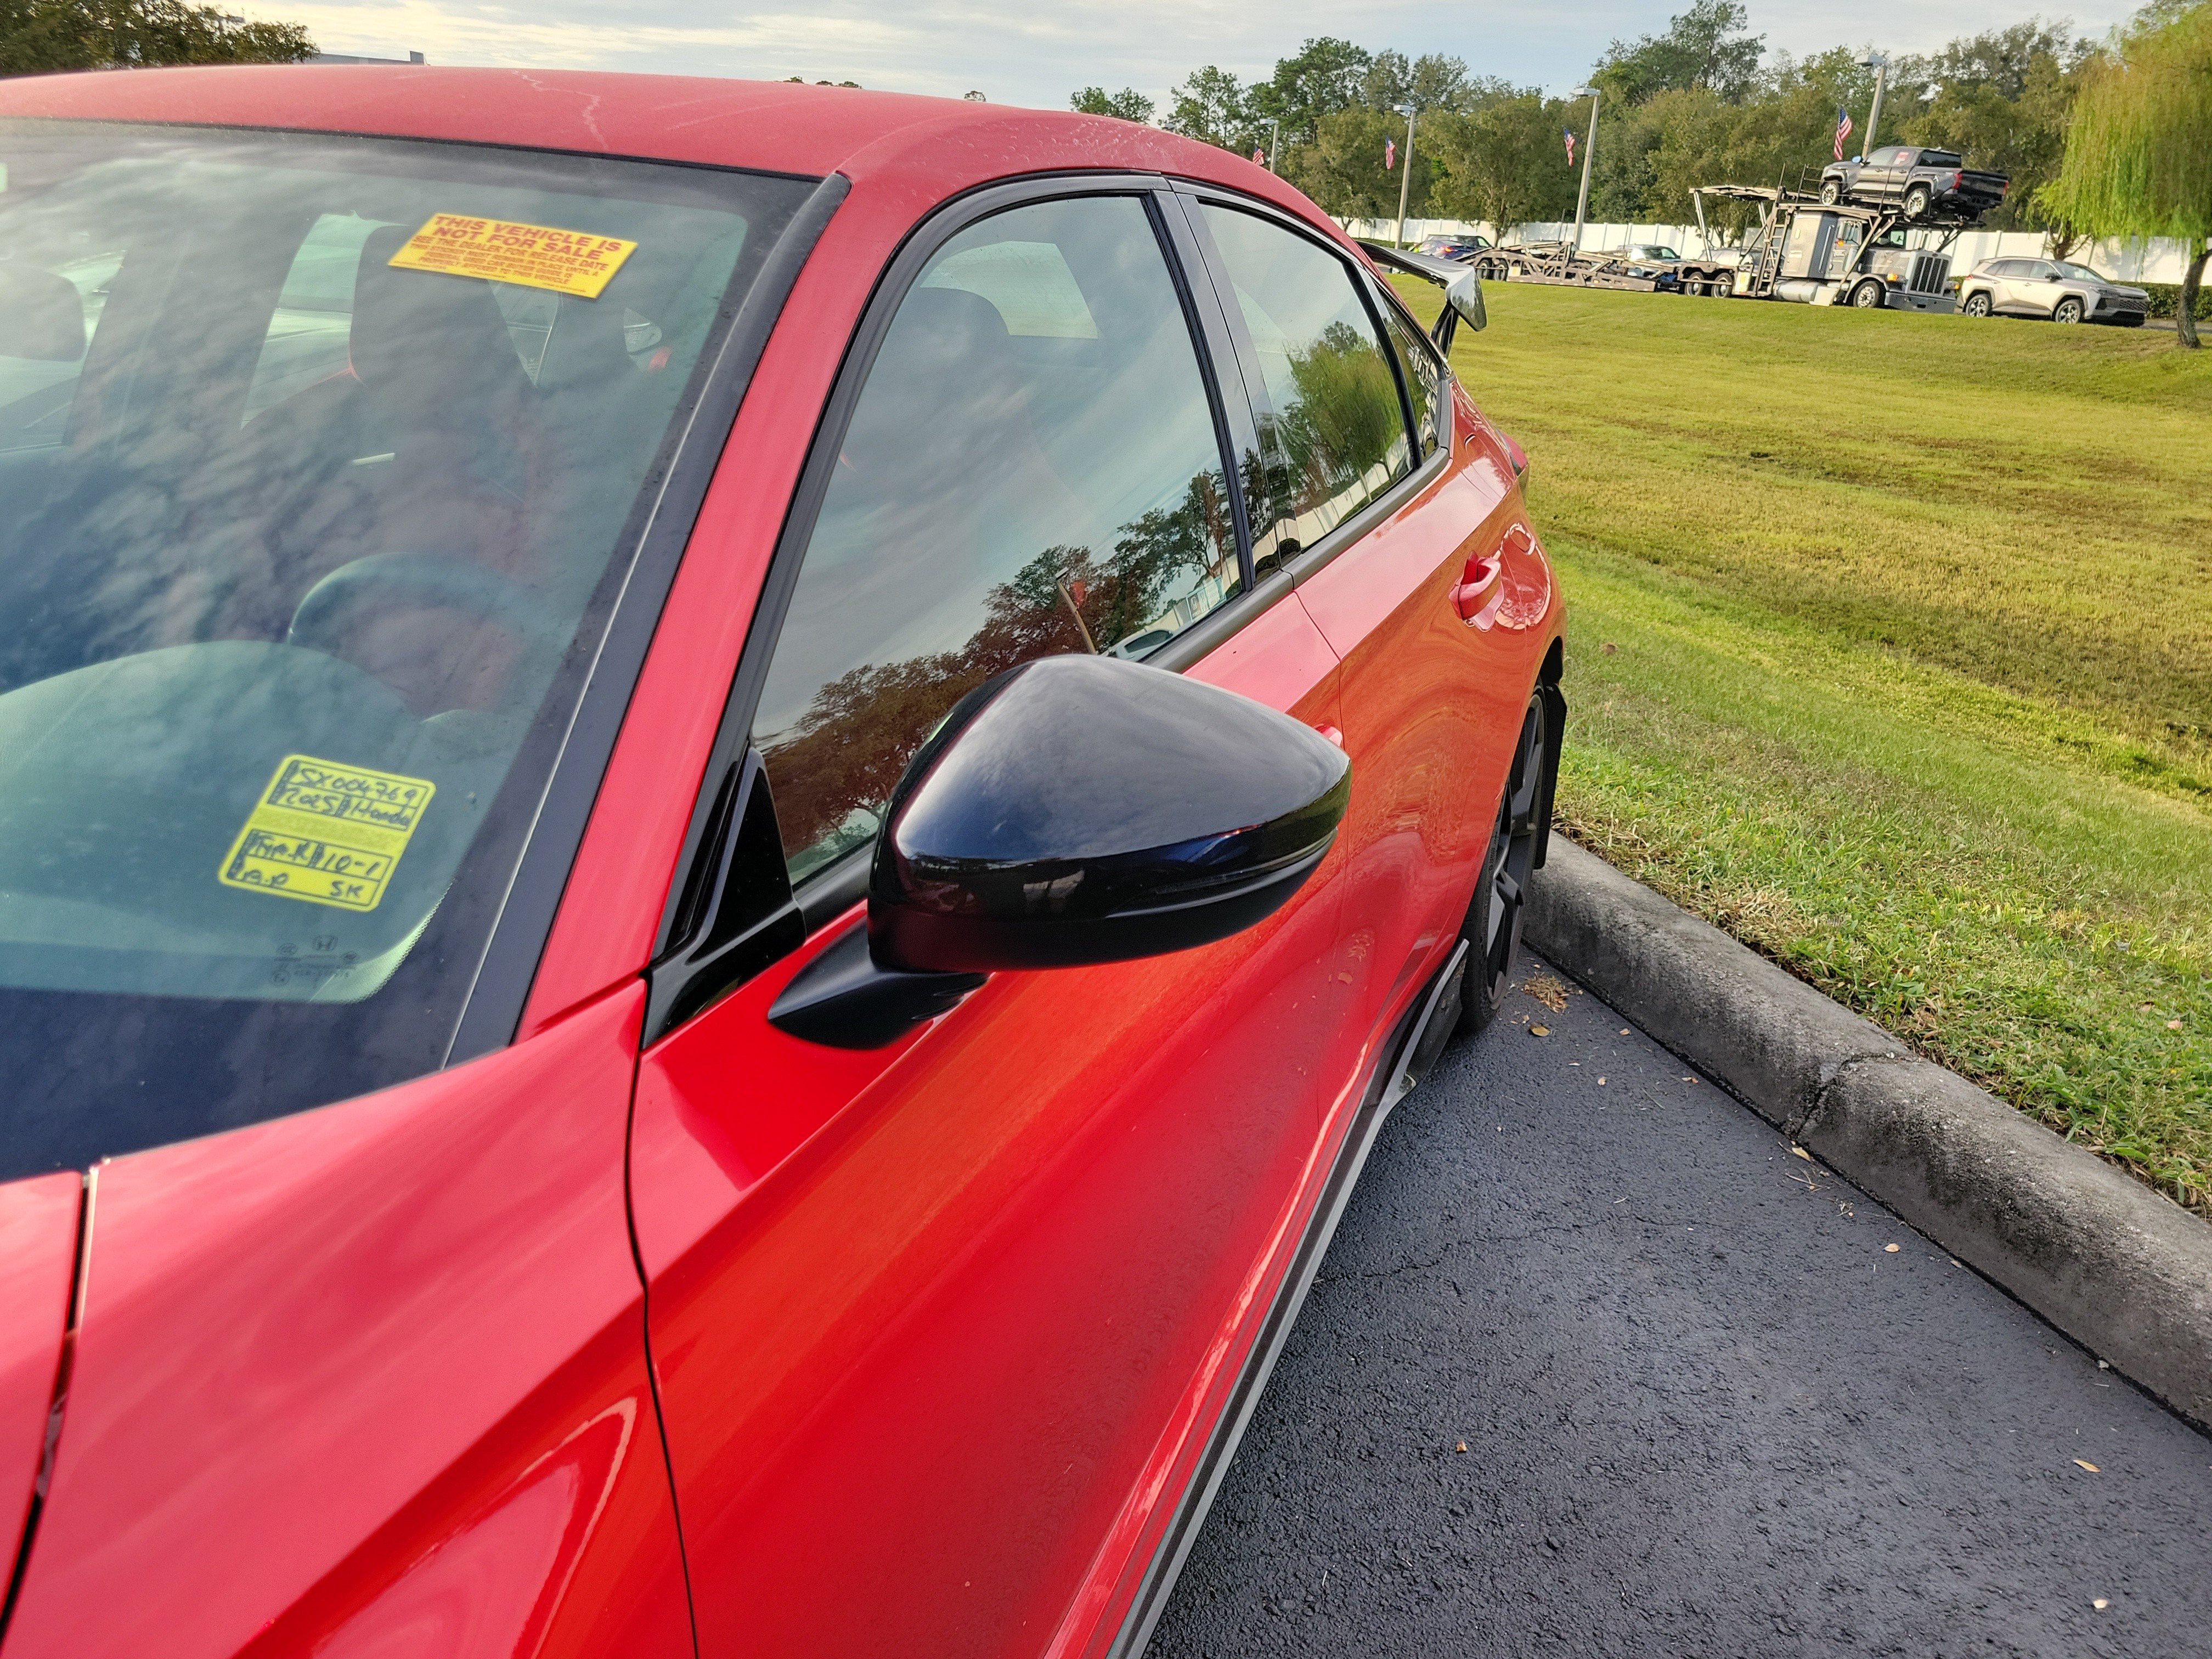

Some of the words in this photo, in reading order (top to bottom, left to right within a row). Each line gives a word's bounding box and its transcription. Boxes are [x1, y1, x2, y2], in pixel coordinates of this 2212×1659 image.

[432, 227, 484, 240] NOT
[486, 234, 538, 248] FOR
[541, 242, 604, 259] SALE
[436, 216, 487, 230] THIS
[494, 224, 594, 246] VEHICLE
[597, 240, 622, 251] IS
[437, 238, 460, 247] THE
[459, 241, 503, 252] DEALER
[504, 247, 528, 256] FOR
[529, 250, 579, 265] RELEASE
[578, 259, 609, 270] DATE
